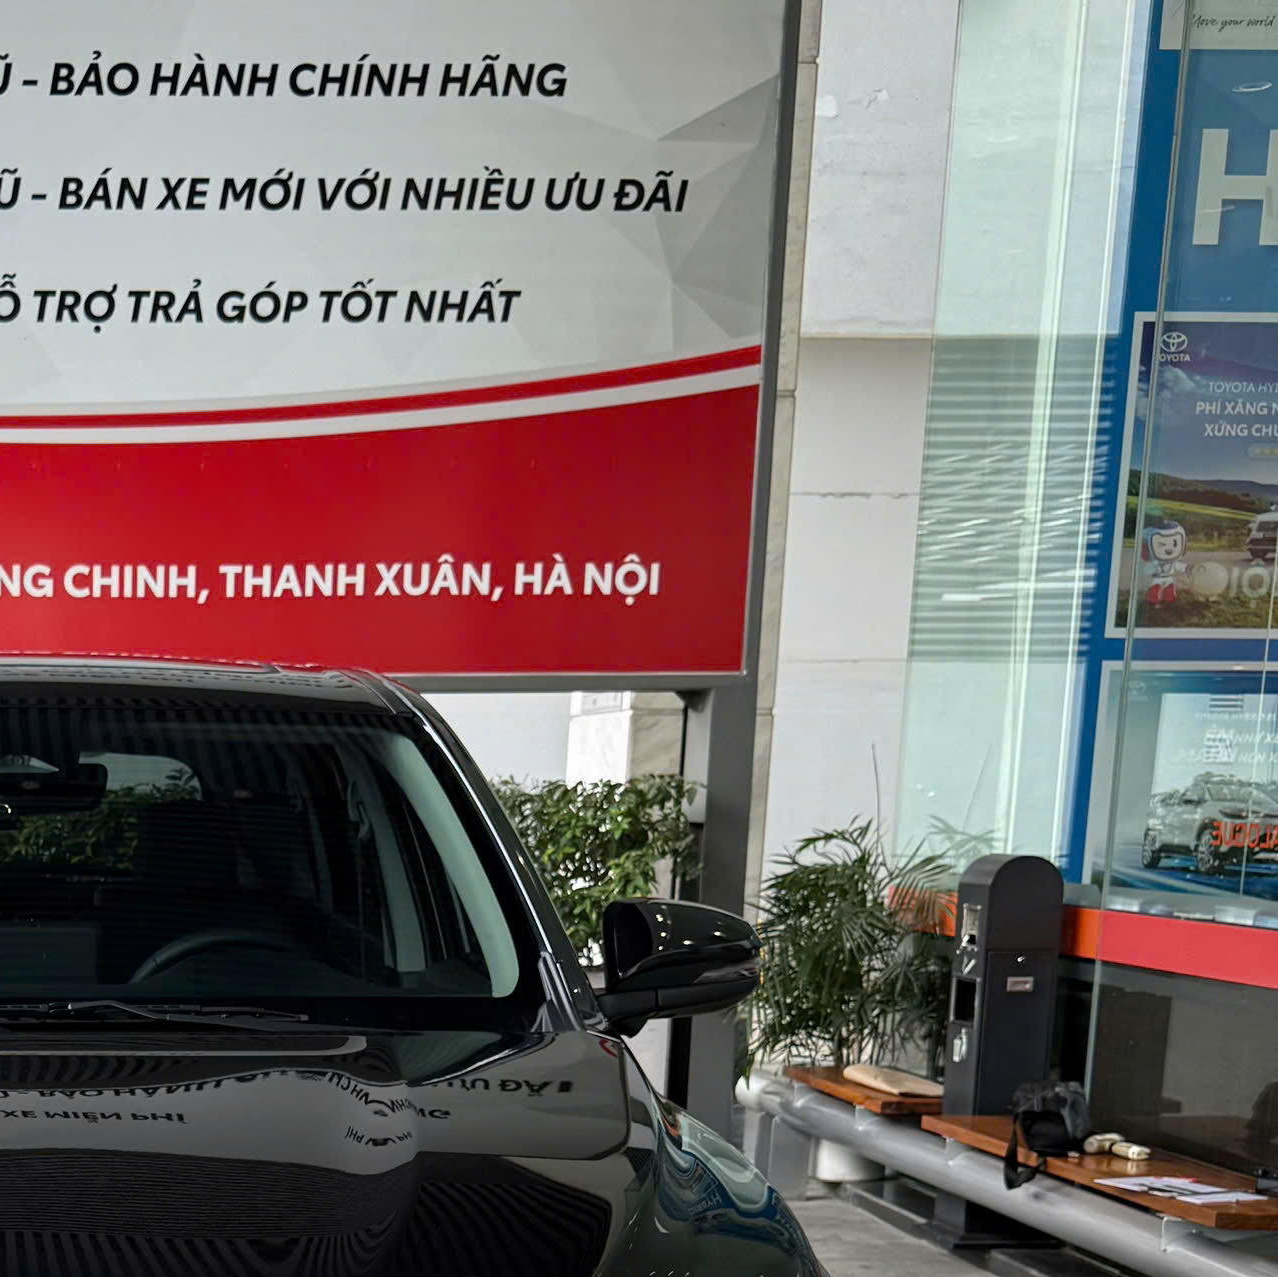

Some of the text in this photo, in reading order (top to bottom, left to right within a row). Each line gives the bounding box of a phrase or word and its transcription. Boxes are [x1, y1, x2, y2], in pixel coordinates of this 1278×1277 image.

[49, 50, 140, 97] BẢO
[149, 53, 279, 97] HÀNH
[289, 53, 430, 97] CHÍNH
[438, 54, 568, 98] HÃNG
[58, 168, 148, 211] BÁN
[155, 177, 211, 210] XE
[218, 168, 306, 211] MỚI
[317, 168, 392, 211] VỚI
[400, 165, 536, 211] NHIỀU
[544, 171, 606, 212] ƯU
[613, 170, 690, 213] ĐÃI
[33, 283, 118, 333] TRỢ
[128, 278, 203, 323] TRẢ
[216, 281, 309, 323] GÓP
[319, 278, 398, 323] TỐT
[404, 278, 522, 323] NHẤT
[1159, 353, 1191, 362] OYOTA
[1196, 399, 1221, 415] PHÍ
[1224, 399, 1268, 415] XĂNG
[1209, 381, 1255, 393] TOYOTA
[63, 564, 209, 604] CHINH,
[219, 564, 365, 598] THANH
[374, 555, 503, 601] XUÂN,
[514, 554, 573, 595] HÀ
[584, 555, 660, 605] NỘI
